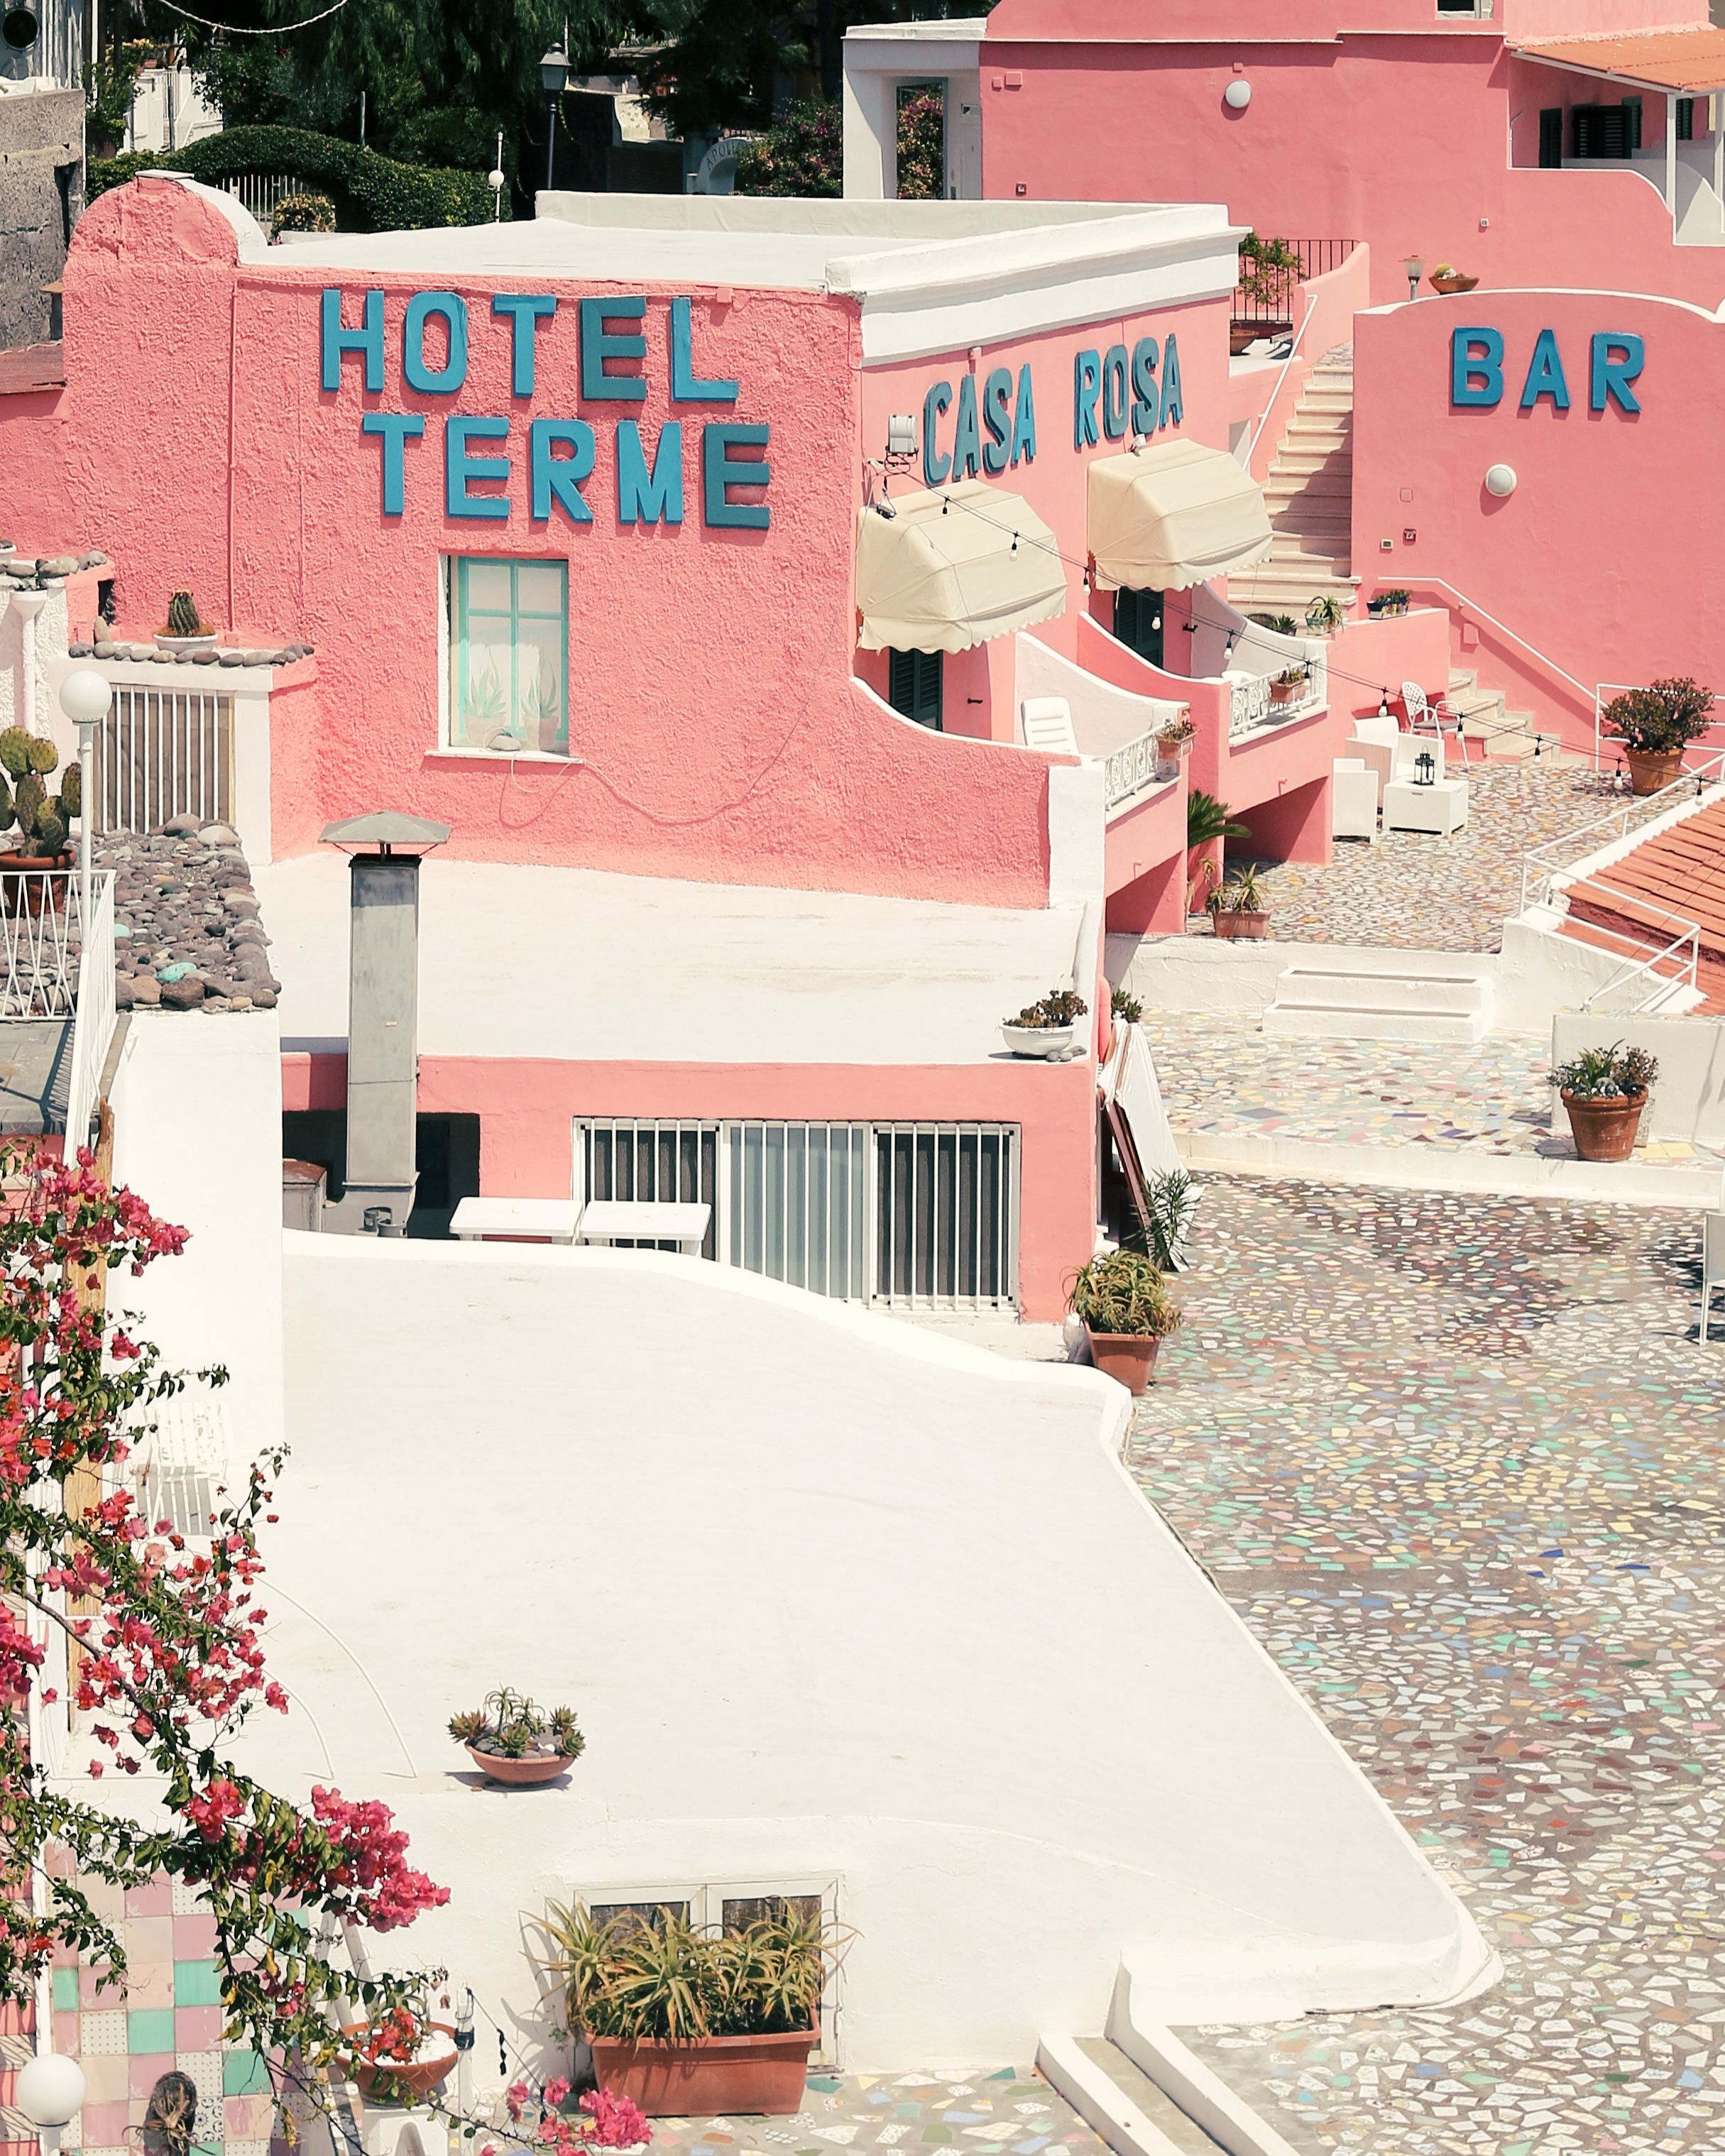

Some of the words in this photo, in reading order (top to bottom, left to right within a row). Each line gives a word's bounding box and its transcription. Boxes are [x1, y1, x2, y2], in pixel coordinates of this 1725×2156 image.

[322, 289, 739, 402] HOTEL
[1452, 326, 1645, 413] BAR
[924, 363, 1037, 486] CASA
[1074, 333, 1183, 448] ROSA
[362, 412, 770, 529] TERME
